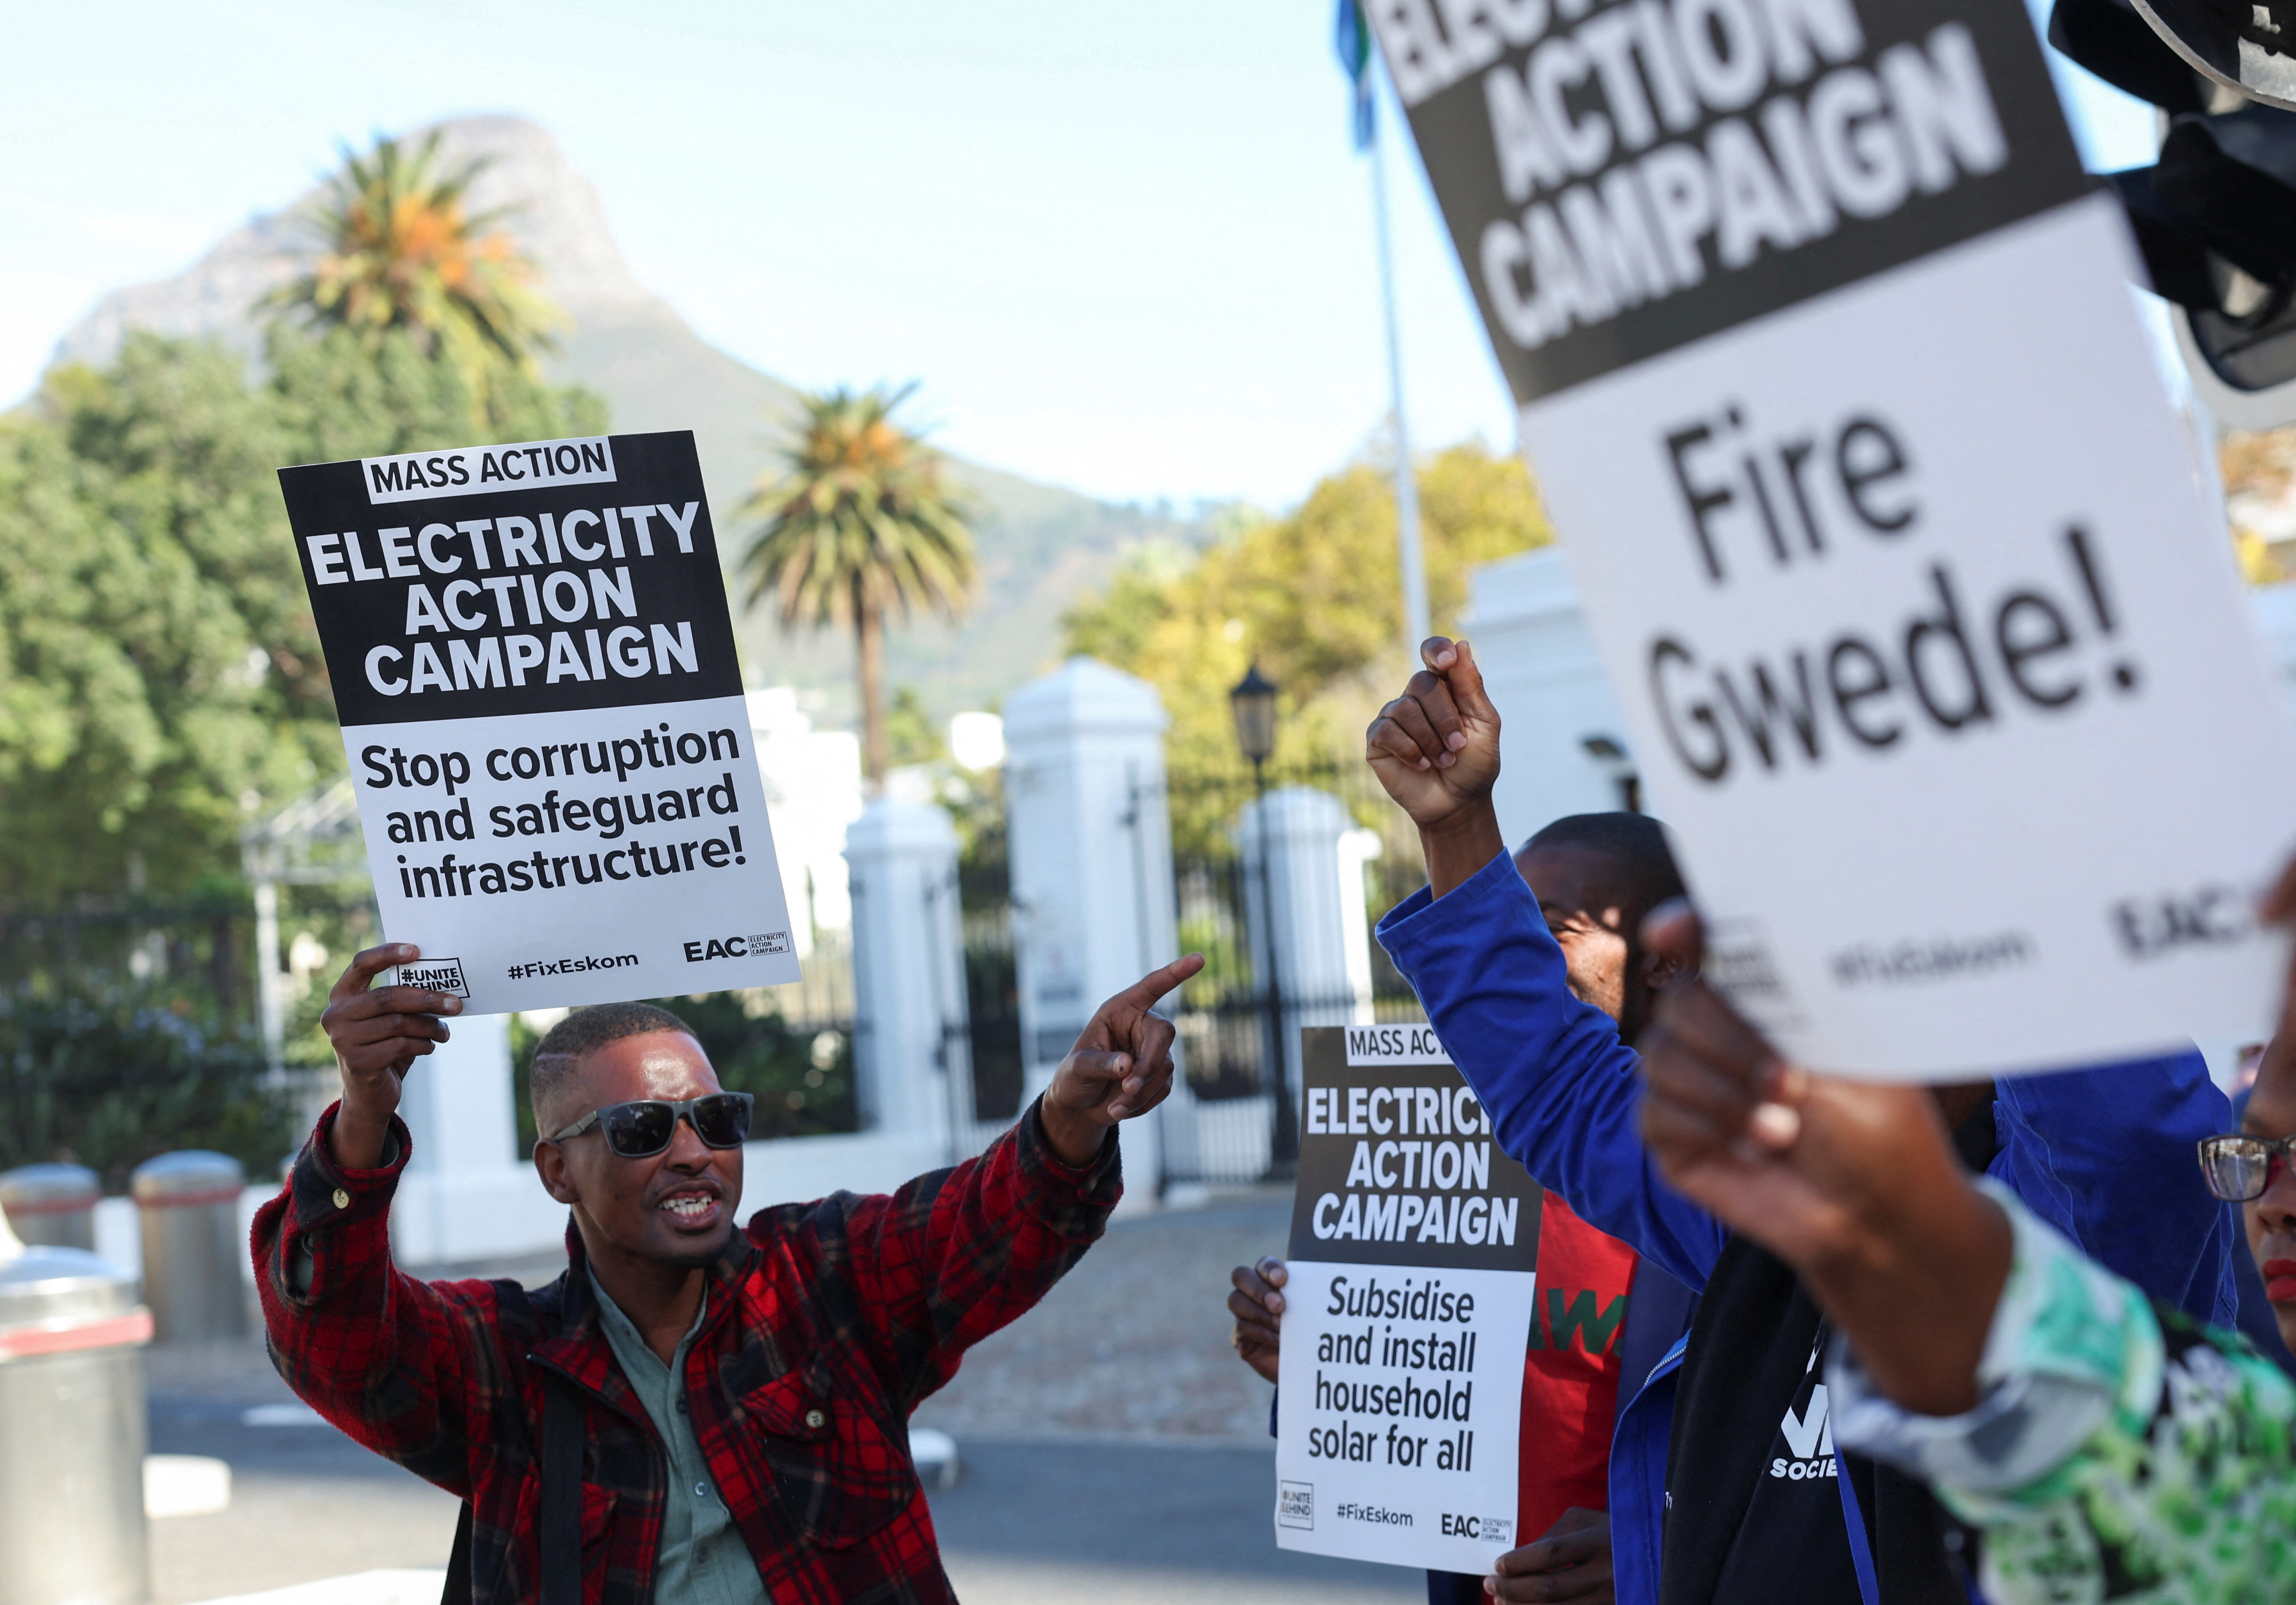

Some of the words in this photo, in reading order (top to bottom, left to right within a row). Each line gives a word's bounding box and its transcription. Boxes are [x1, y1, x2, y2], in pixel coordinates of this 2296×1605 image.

[1484, 0, 1864, 203] ACTION
[1480, 20, 2009, 350] CAMPAIGN
[370, 455, 470, 494] MASS
[480, 443, 608, 484] ACTION
[1664, 403, 1920, 584] Fire
[306, 501, 700, 586] ELECTRICITY
[404, 566, 638, 635] ACTION
[364, 621, 699, 697] CAMPAIGN
[1647, 520, 2139, 783] Gwede!
[361, 744, 471, 796] Stop
[486, 723, 740, 782] corruption
[386, 798, 475, 843] and
[489, 772, 739, 839] safeguard
[396, 825, 746, 898] infrastructure!
[683, 937, 748, 962] EAC
[750, 933, 785, 943] ELECTRICITY
[752, 946, 783, 955] CAMPAIGN
[401, 967, 459, 982] #UNITE
[508, 954, 639, 979] #FixEskom
[1350, 1030, 1405, 1056] MASS
[1346, 1140, 1490, 1190] ACTION
[1312, 1193, 1518, 1245] CAMPAIGN
[1327, 1276, 1474, 1323] Subsidise
[1317, 1325, 1371, 1366] and
[1382, 1325, 1476, 1372] install
[1315, 1370, 1472, 1421] household
[1309, 1420, 1378, 1460] solar
[1387, 1424, 1428, 1466] for
[1437, 1430, 1473, 1472] all
[1337, 1503, 1413, 1527] #FixEskom
[1442, 1513, 1480, 1538] EAC
